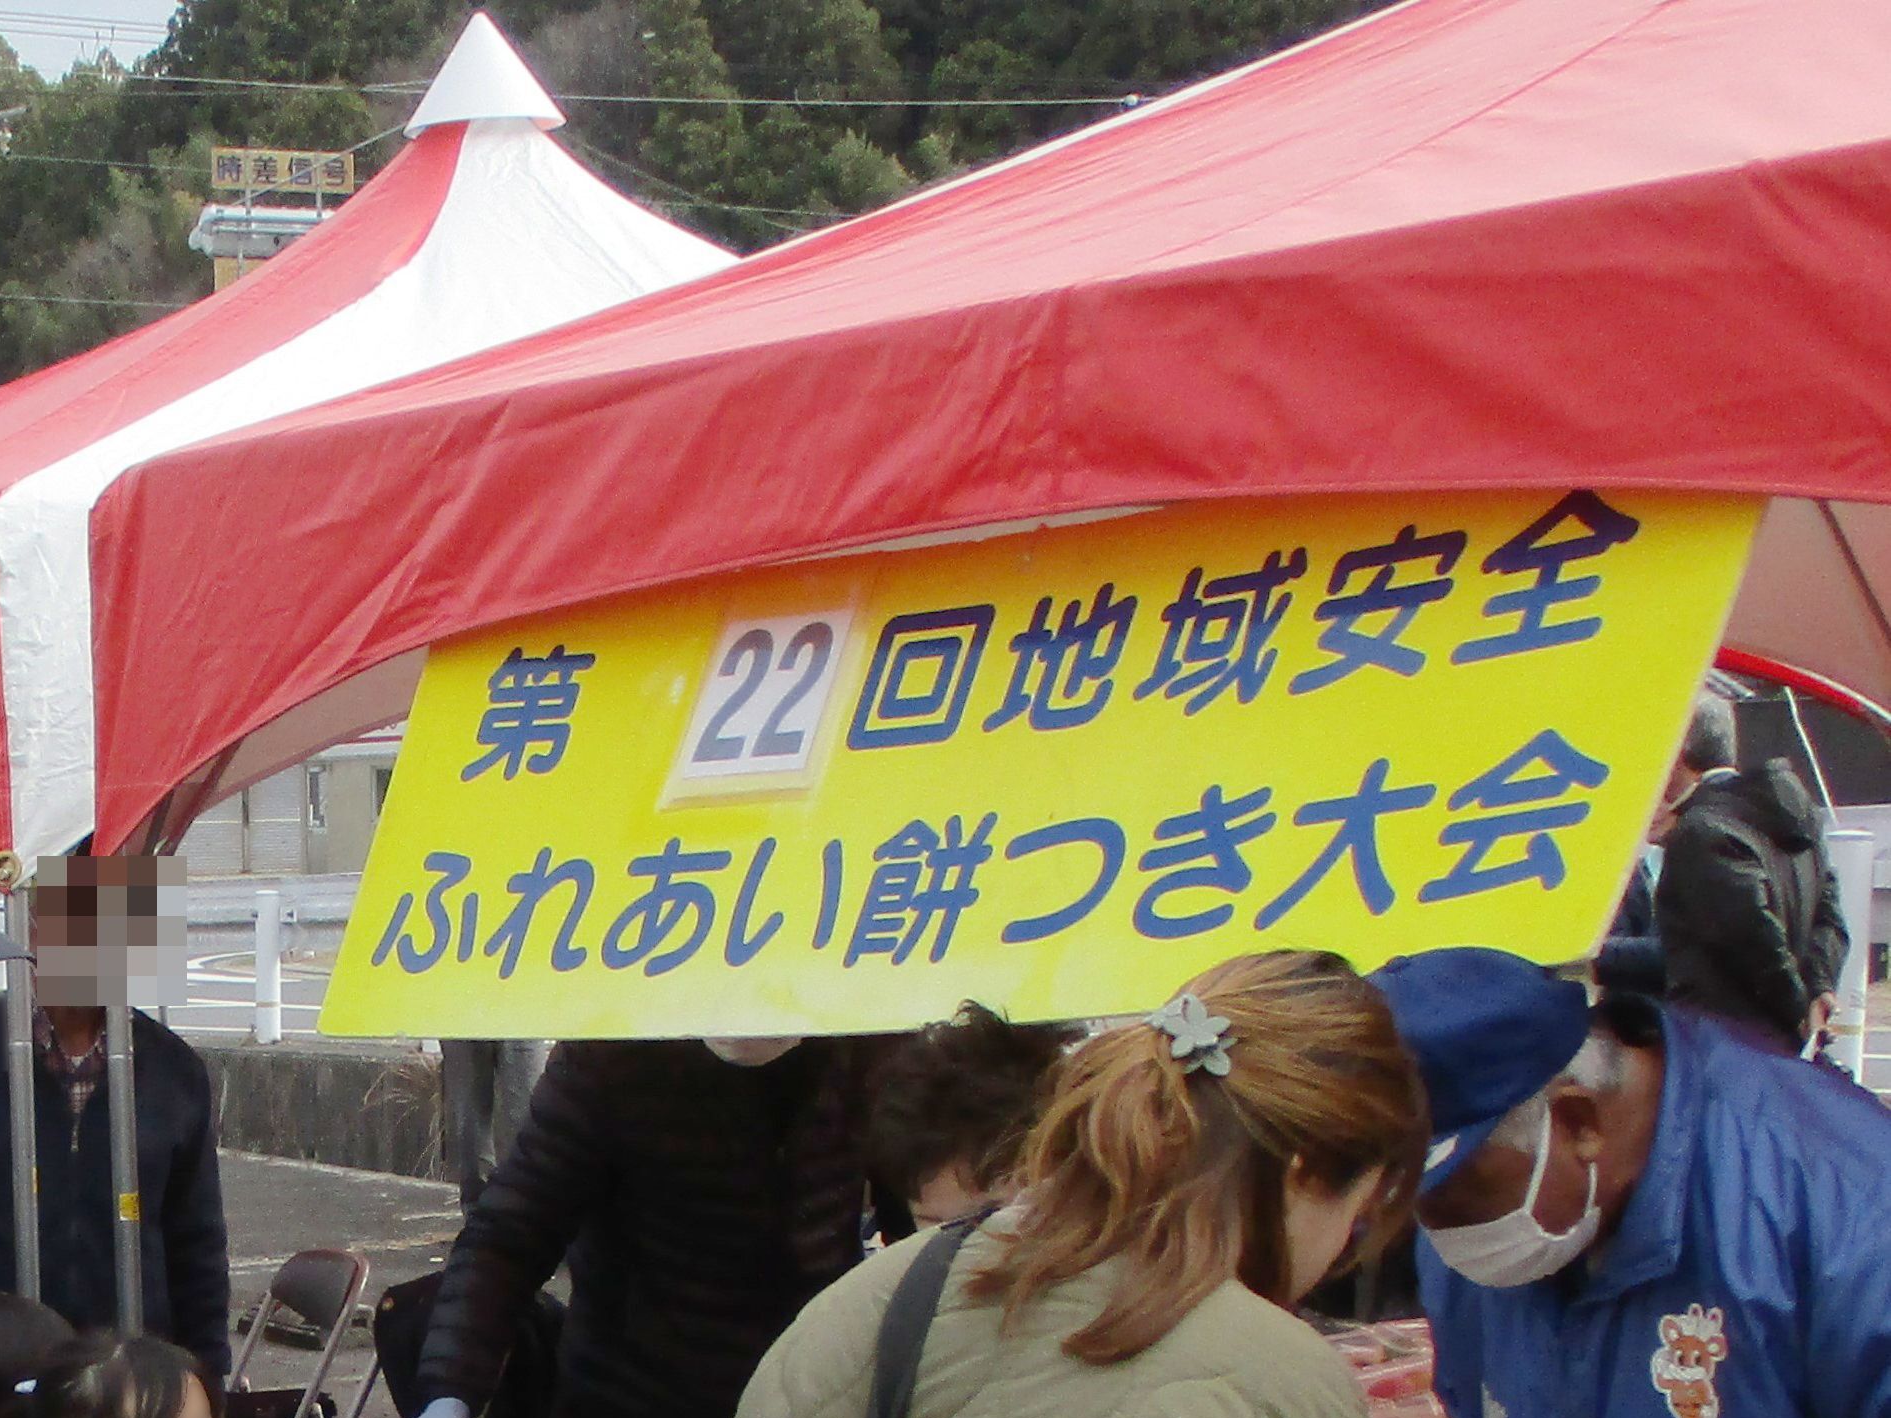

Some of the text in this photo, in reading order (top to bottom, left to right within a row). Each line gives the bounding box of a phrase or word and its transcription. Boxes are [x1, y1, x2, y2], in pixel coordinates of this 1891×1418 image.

[372, 729, 1609, 977] ふれあい餅つき大会
